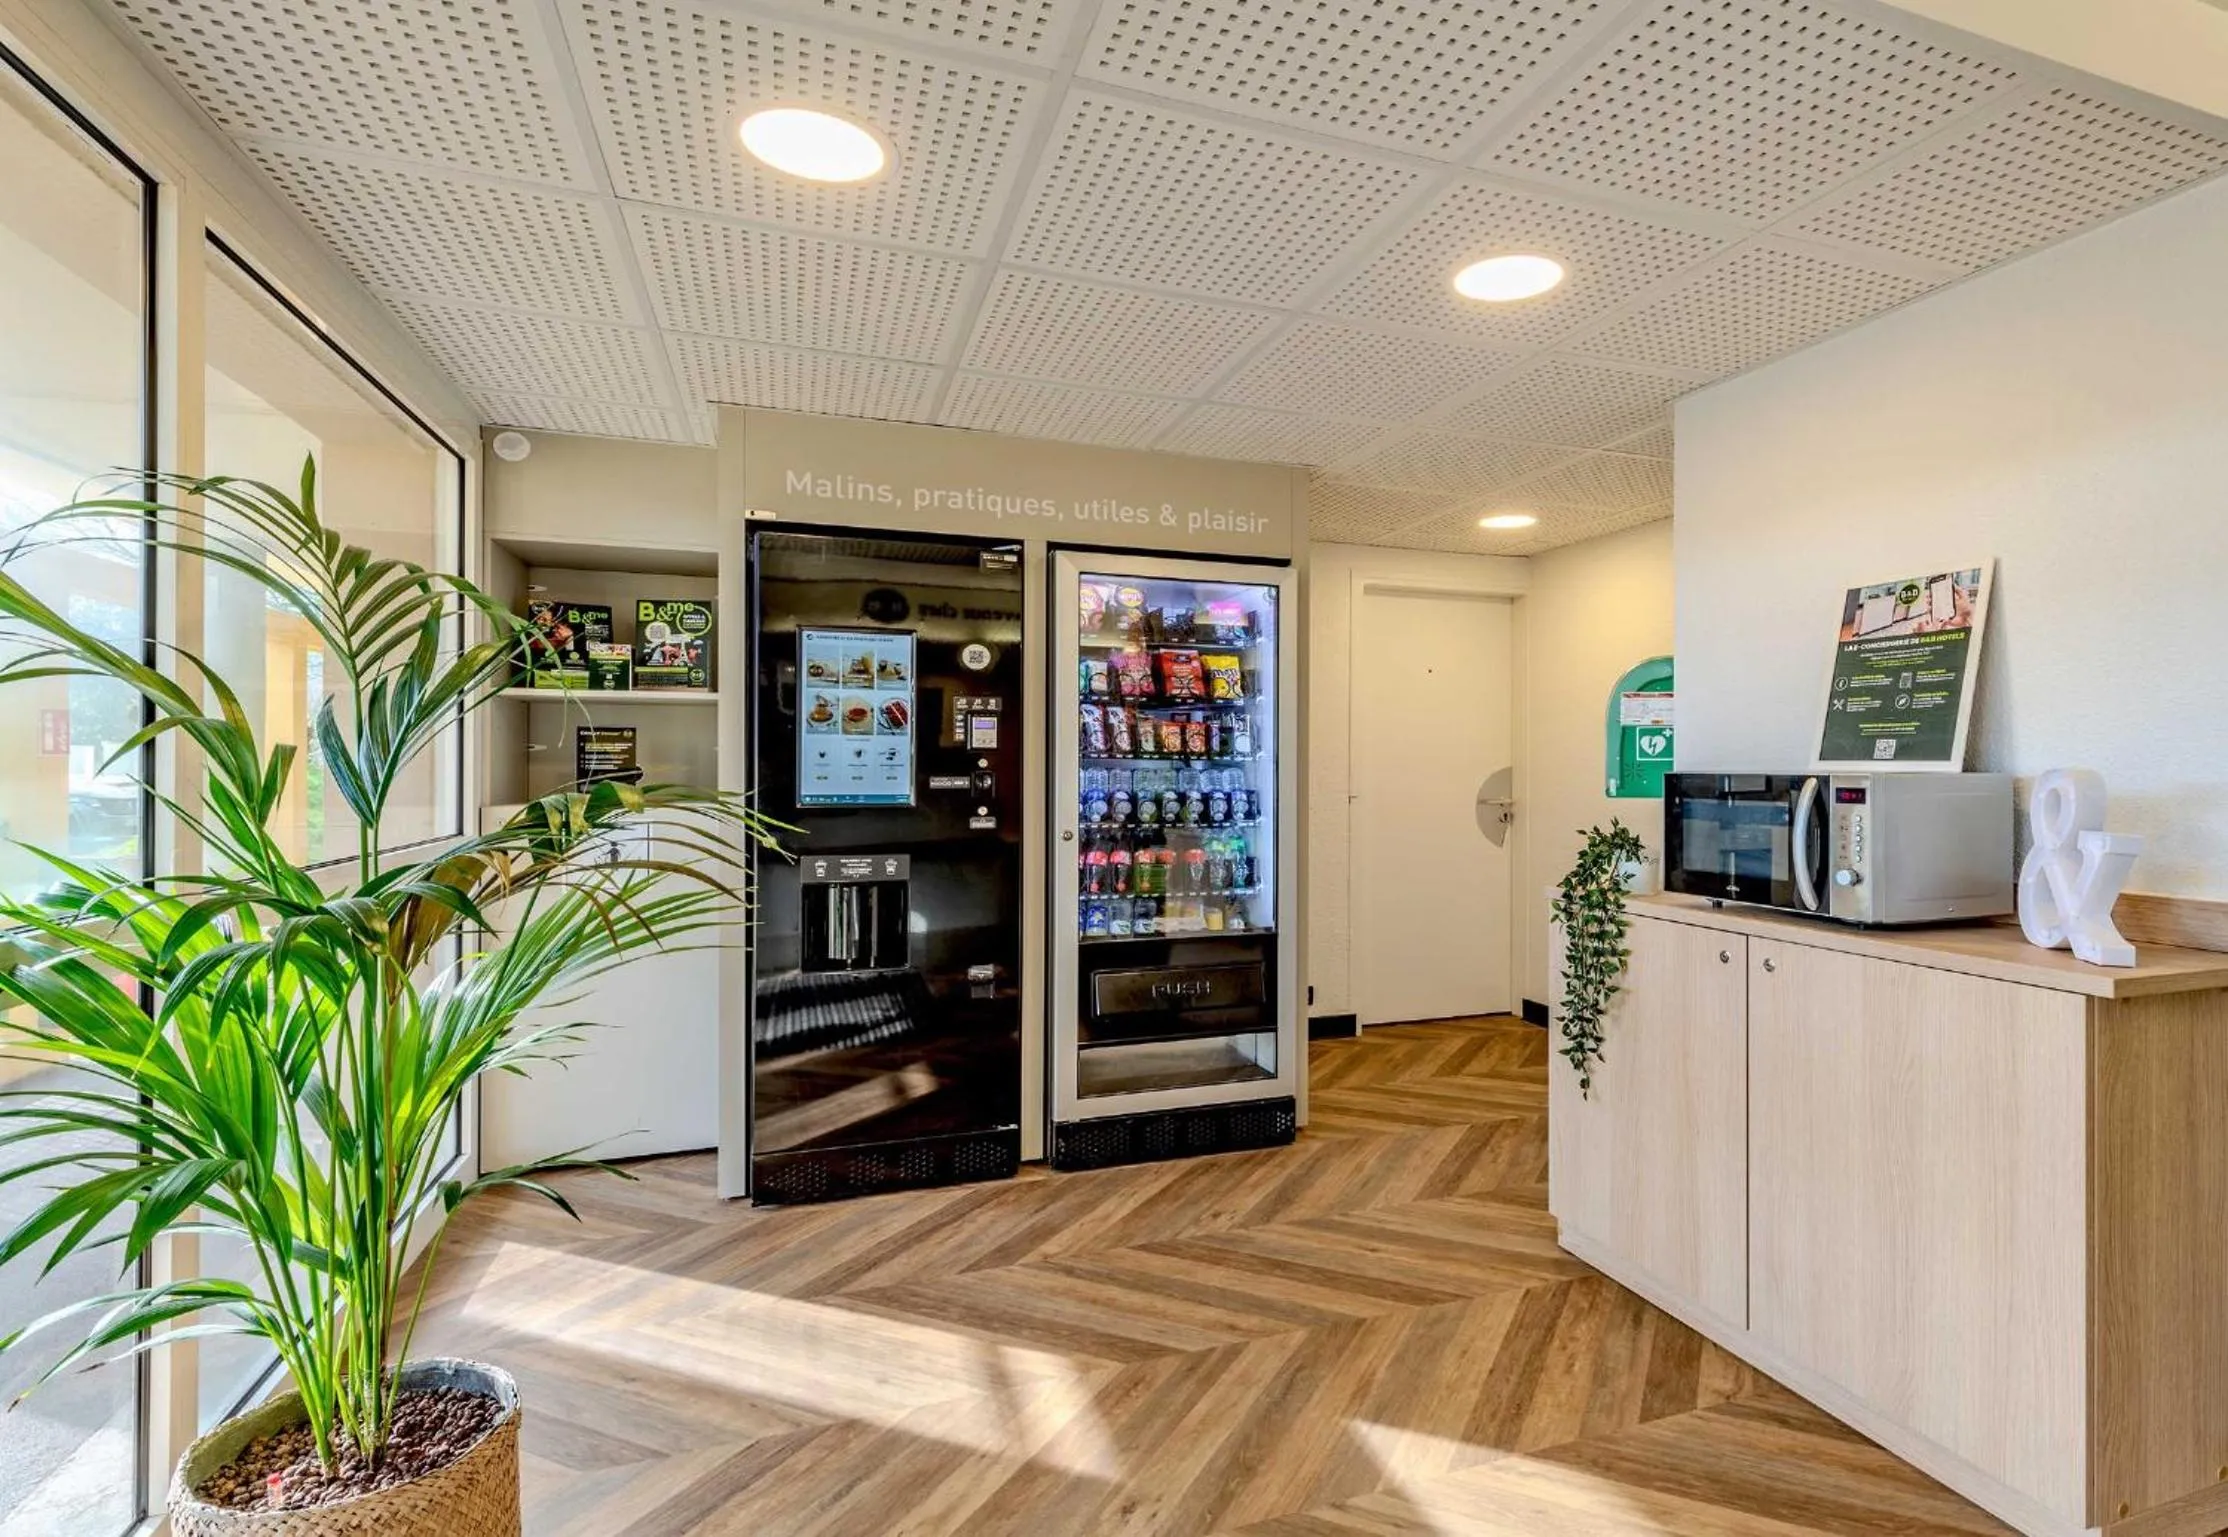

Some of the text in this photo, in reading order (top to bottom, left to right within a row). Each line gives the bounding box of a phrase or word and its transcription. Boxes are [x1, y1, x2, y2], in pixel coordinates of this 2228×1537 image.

[785, 469, 1269, 534] Malins, pratiques, utiles & plaisir
[639, 602, 695, 622] B&me
[1151, 980, 1212, 998] PUSH
